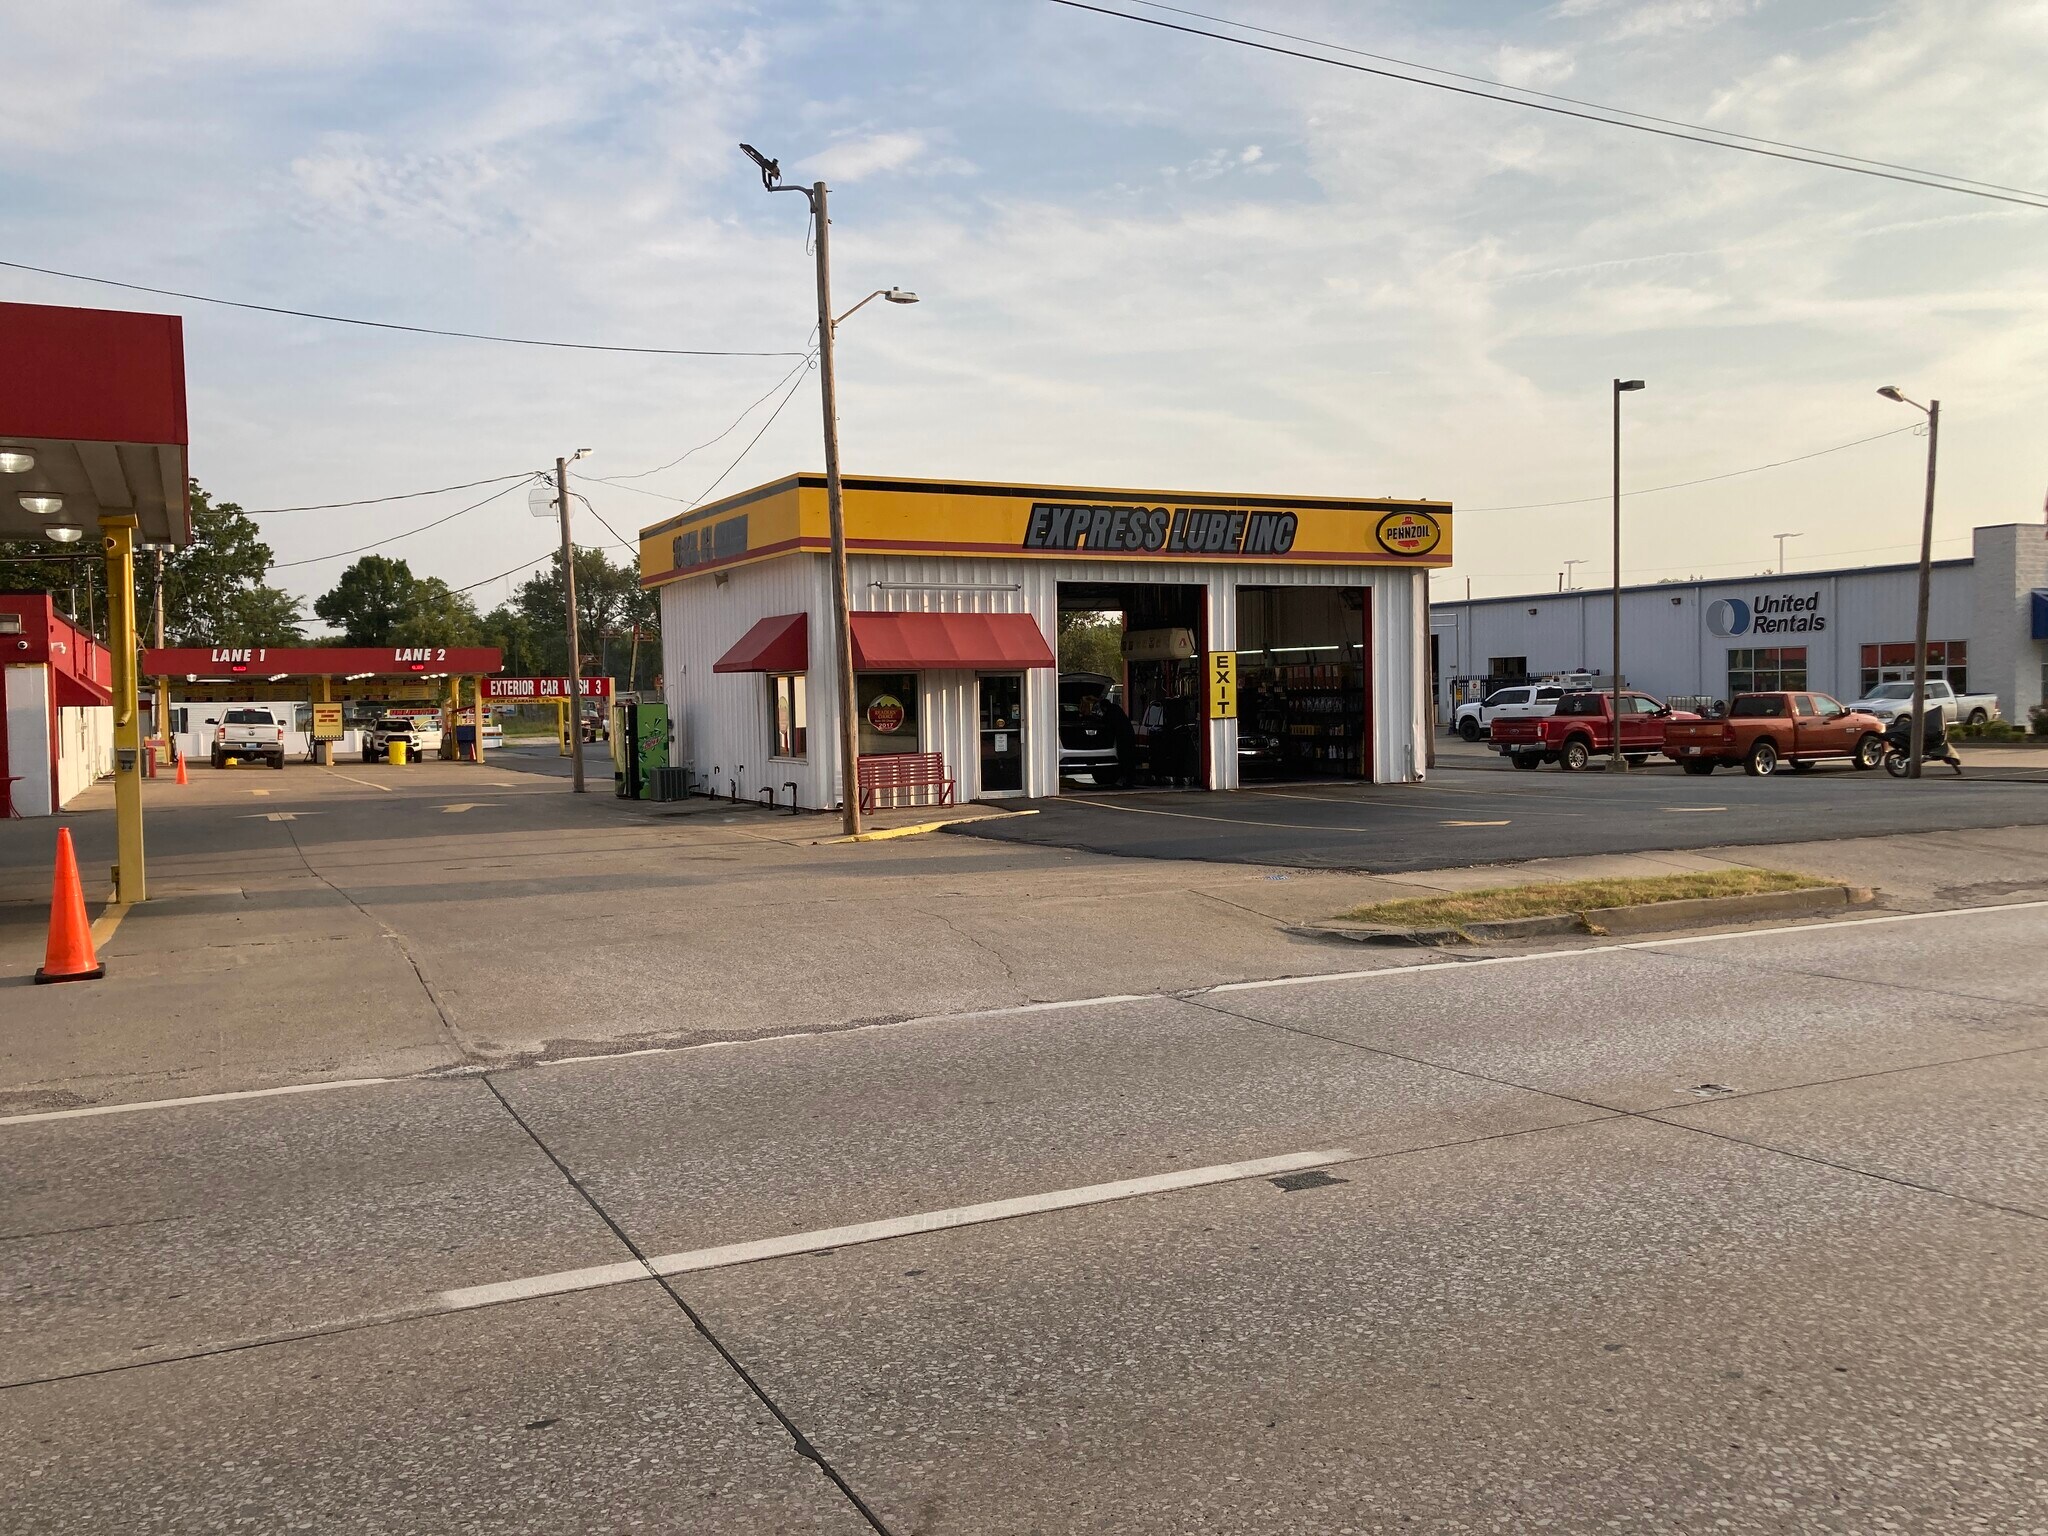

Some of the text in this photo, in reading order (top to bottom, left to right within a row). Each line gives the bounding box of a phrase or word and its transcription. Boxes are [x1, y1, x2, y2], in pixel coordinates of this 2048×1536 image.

[1024, 504, 1297, 553] EXPRESS LUBE INC
[1386, 524, 1431, 541] PENNZOIL
[1753, 591, 1819, 614] United
[1753, 613, 1826, 634] Rentals
[211, 648, 266, 662] LANE 1
[394, 648, 446, 661] LANE 2
[490, 679, 602, 696] EXTERIOR CAR WSH 3
[1215, 655, 1231, 715] EXIT
